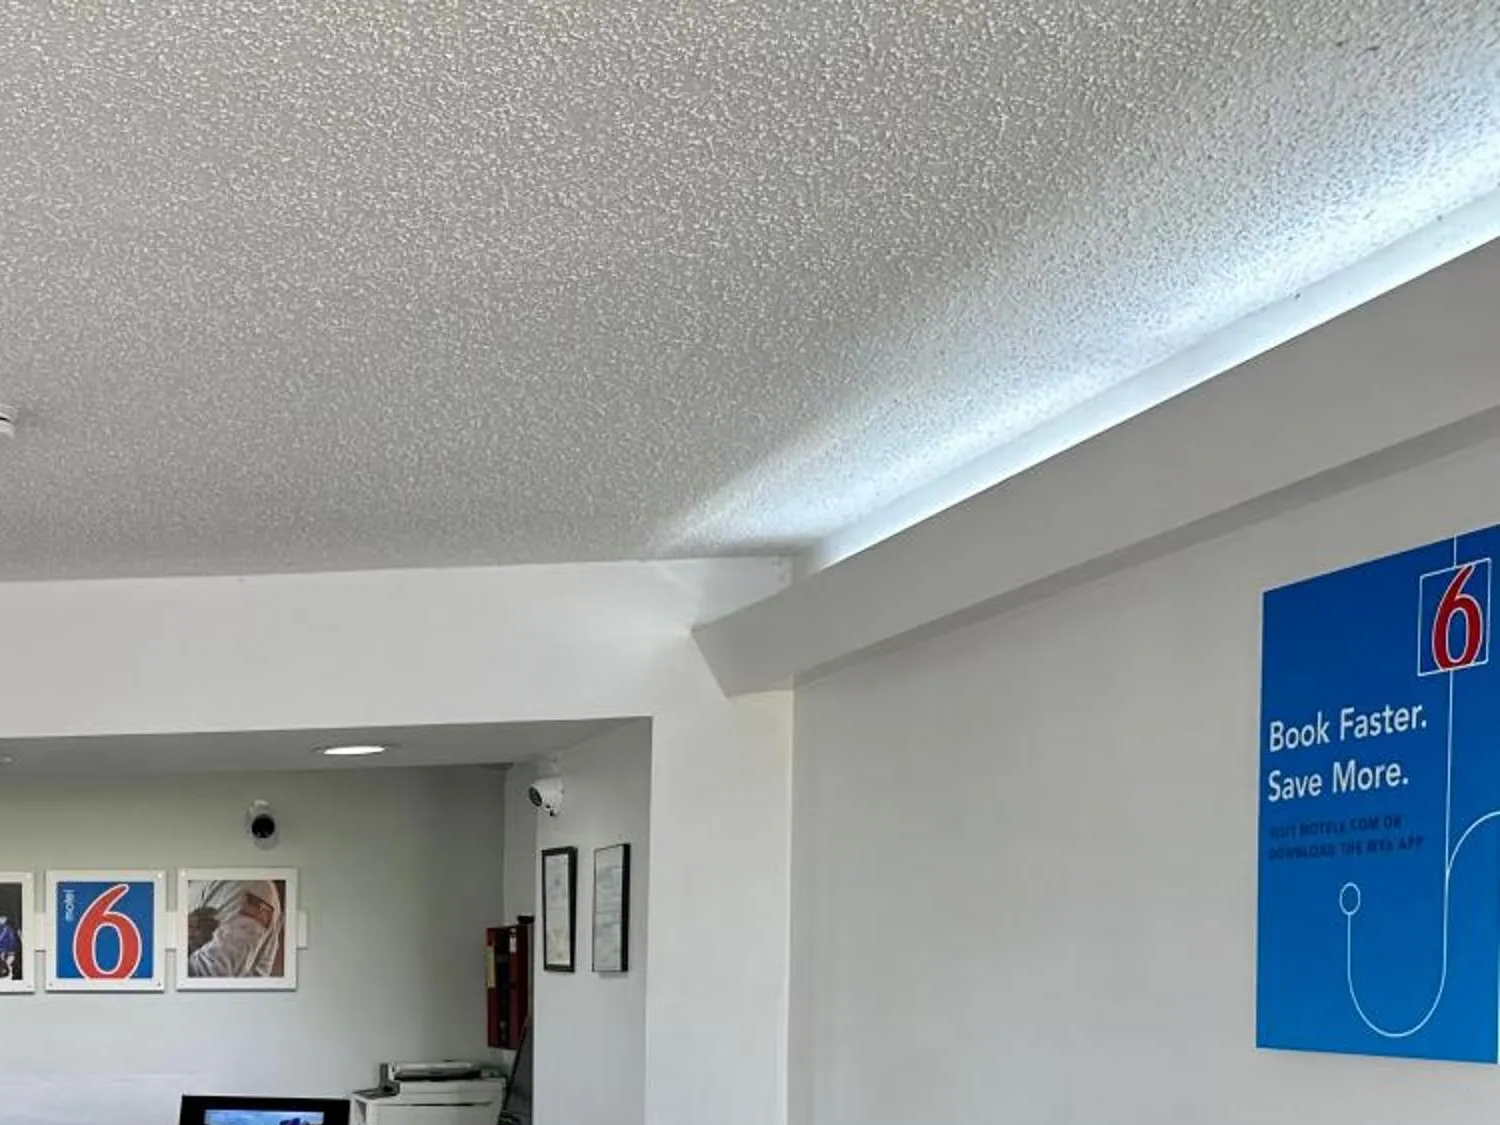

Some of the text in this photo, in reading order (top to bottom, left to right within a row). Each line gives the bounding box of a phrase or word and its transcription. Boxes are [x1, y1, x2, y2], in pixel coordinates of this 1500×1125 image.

[1431, 563, 1483, 672] 6
[1269, 703, 1428, 753] Book Faster.
[1268, 759, 1409, 802] Save More.
[1340, 840, 1364, 857] THE
[1399, 833, 1426, 850] APP
[72, 883, 143, 981] 6
